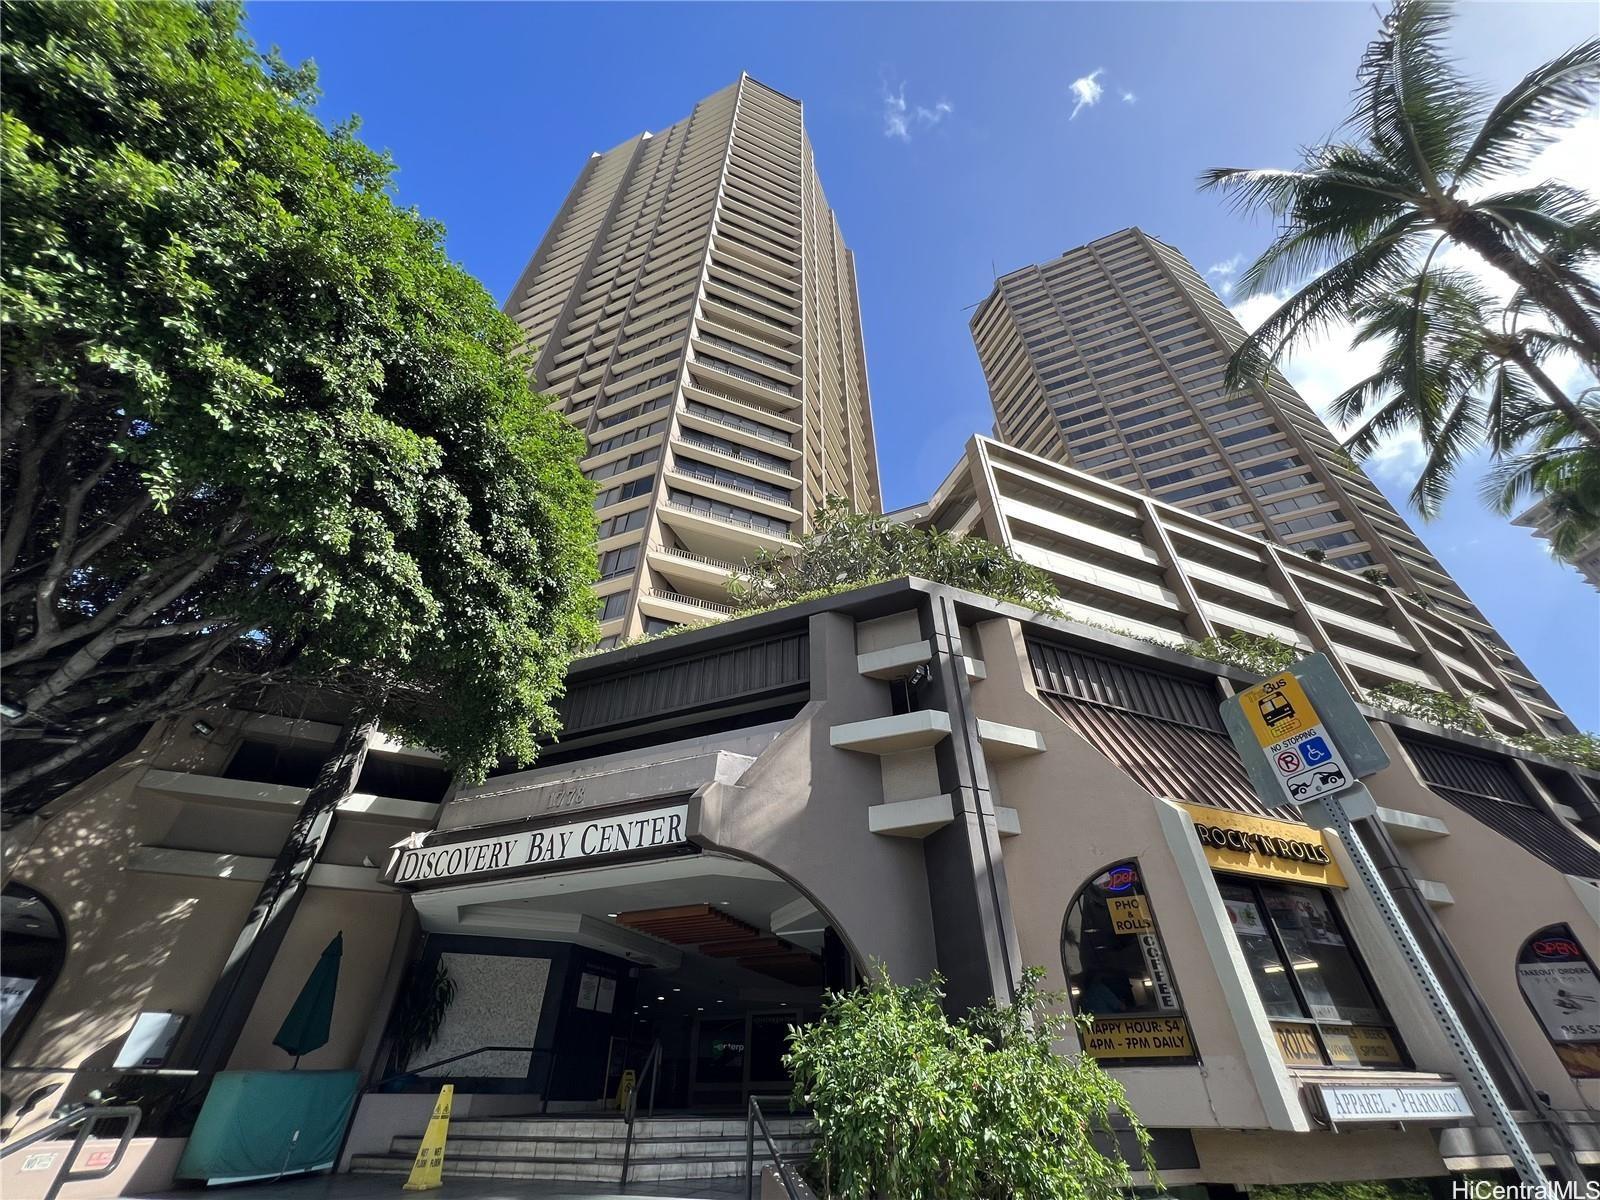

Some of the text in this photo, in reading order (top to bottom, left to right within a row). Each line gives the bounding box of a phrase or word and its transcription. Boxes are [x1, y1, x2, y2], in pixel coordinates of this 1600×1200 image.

[1270, 744, 1282, 754] NO
[1284, 728, 1317, 749] STOPPING
[546, 786, 586, 809] 1778
[399, 813, 683, 882] DISCOVERY BAY CENTER
[1195, 822, 1254, 852] ROCK
[1277, 838, 1331, 865] ROLLS
[1115, 899, 1140, 911] PHO
[1116, 919, 1152, 931] ROLLS
[1532, 941, 1580, 956] OPEN
[1142, 935, 1174, 1008] COFFEE
[1519, 967, 1592, 977] TAKEOUT ORDERS
[1125, 1021, 1164, 1034] HOUR:
[1166, 1020, 1180, 1034] $4
[1089, 1038, 1115, 1050] 4PM
[1125, 1037, 1151, 1050] 7PM
[1153, 1036, 1185, 1049] DAILY
[1278, 1027, 1321, 1061] ROLLS
[1332, 1087, 1462, 1114] APPAREL PHARMACY
